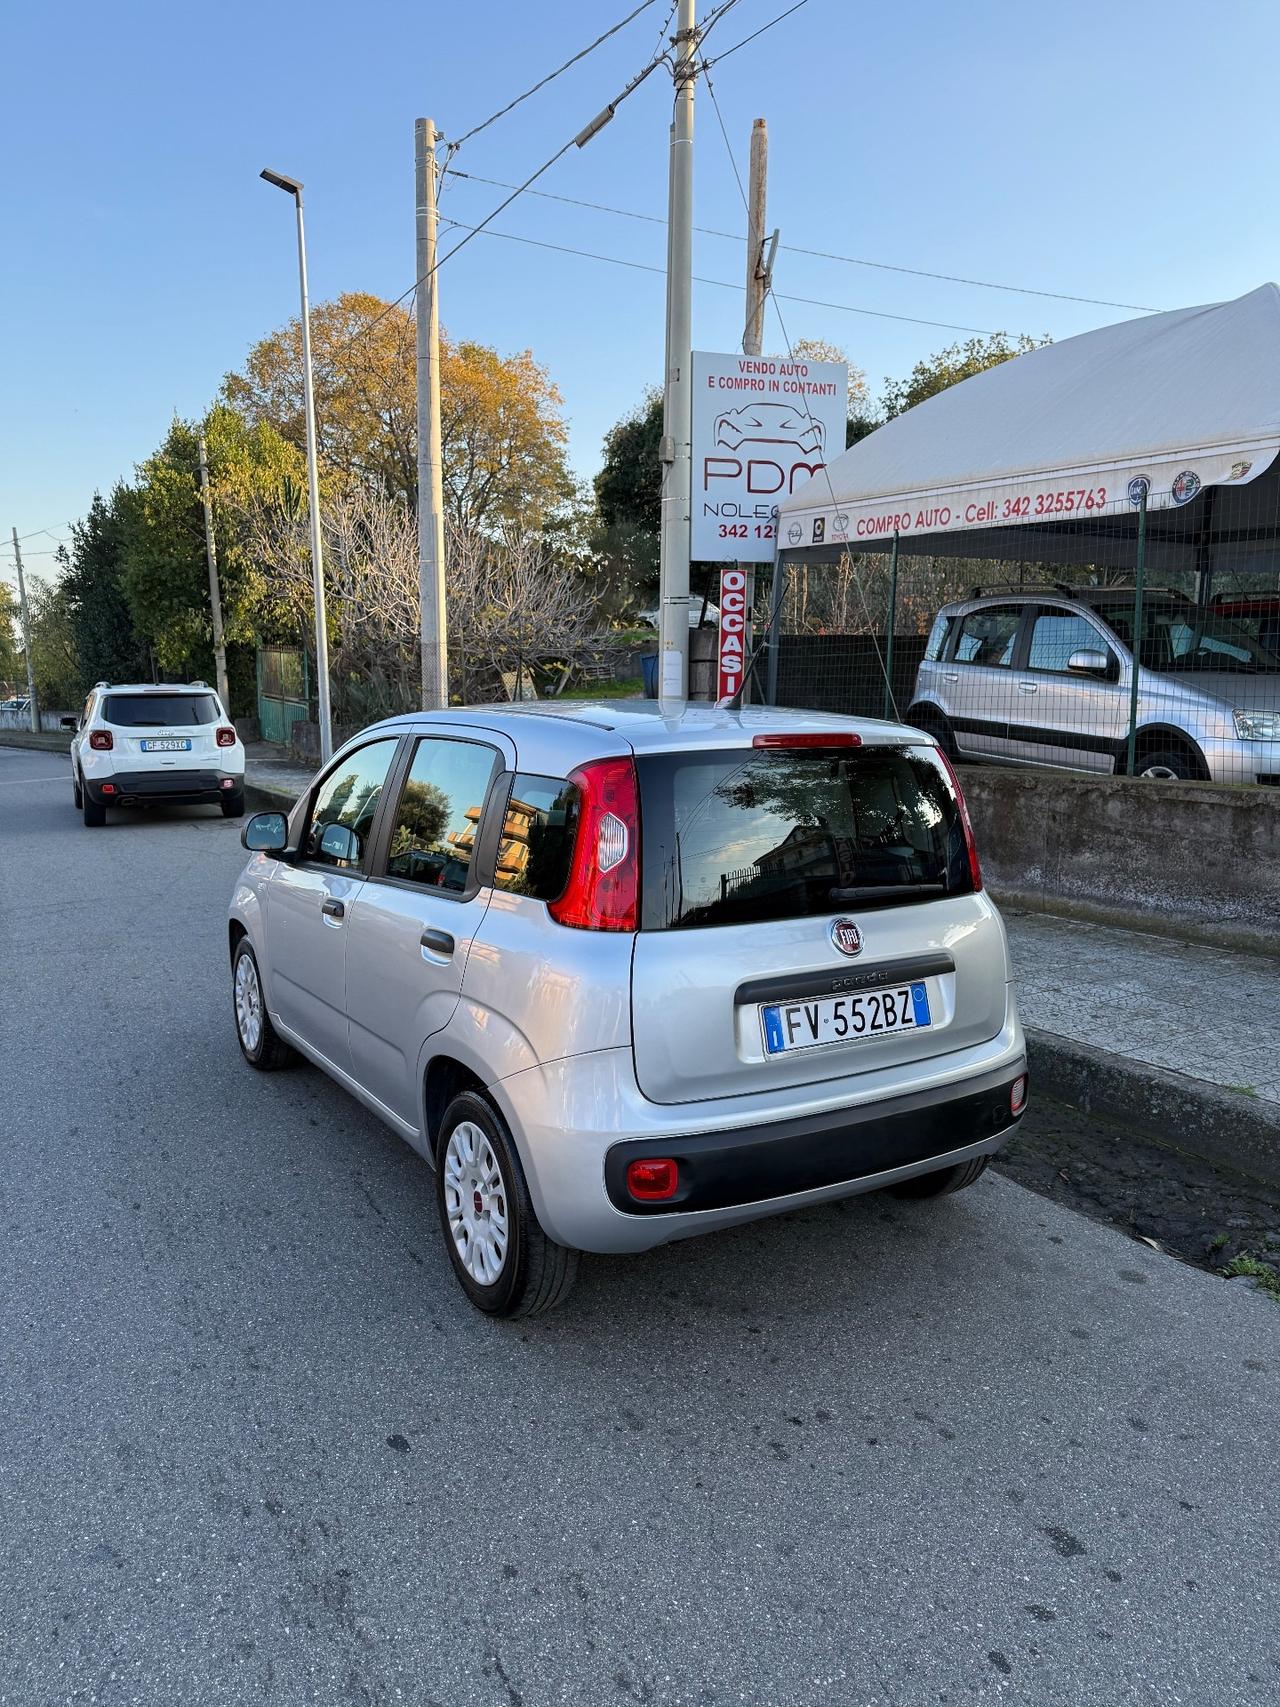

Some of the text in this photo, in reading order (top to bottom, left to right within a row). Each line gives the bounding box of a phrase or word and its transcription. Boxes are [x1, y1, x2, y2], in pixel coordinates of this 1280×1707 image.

[739, 360, 808, 377] VENDO AUTO
[708, 376, 837, 396] E COMPRO IN CONTANTI
[856, 512, 911, 536] COMPRO
[915, 506, 951, 529] AUTO
[965, 501, 998, 523] Cell:
[1002, 496, 1031, 518] 342
[1034, 487, 1107, 515] 3255763
[718, 524, 748, 538] 342
[840, 928, 859, 945] FIAT
[832, 969, 888, 991] panda
[785, 1004, 819, 1044] FV
[833, 990, 913, 1036] 552BZ
